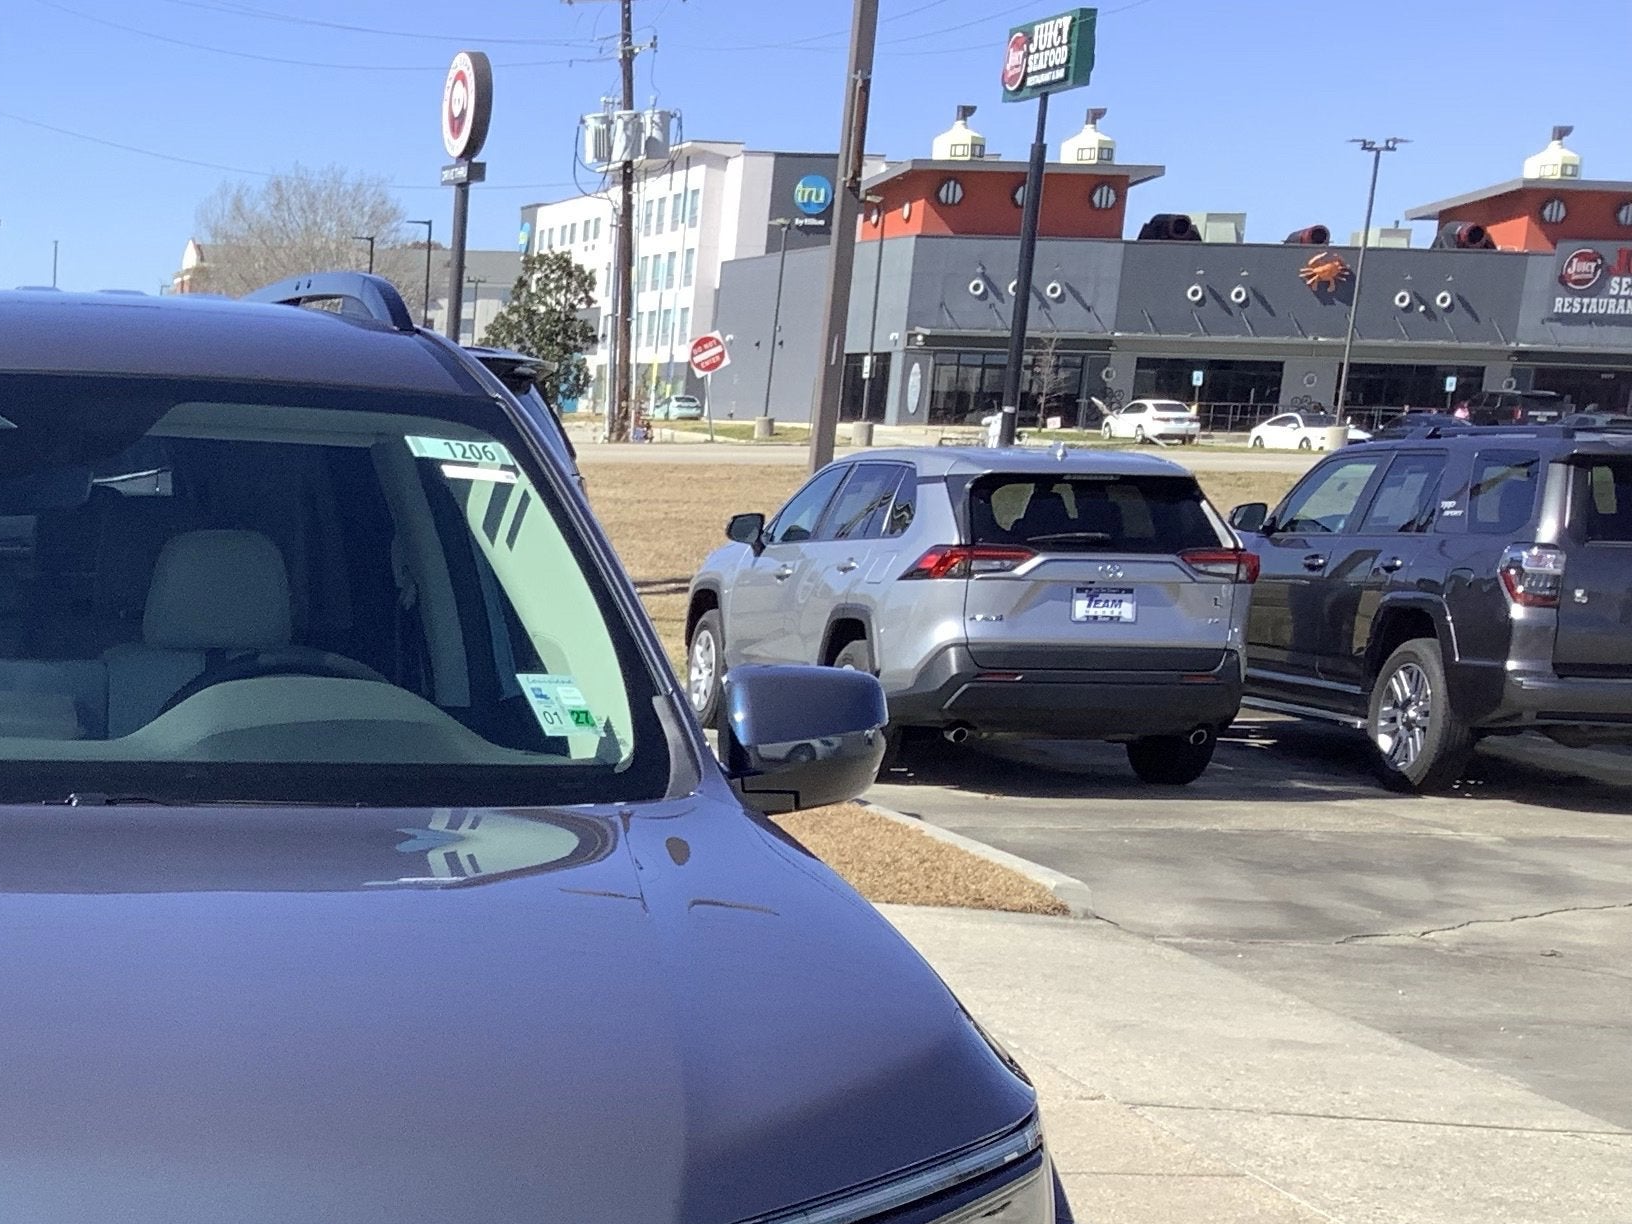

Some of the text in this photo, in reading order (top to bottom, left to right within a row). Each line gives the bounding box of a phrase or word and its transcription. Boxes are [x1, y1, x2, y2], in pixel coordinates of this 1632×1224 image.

[1029, 15, 1072, 53] JUICY
[1027, 45, 1068, 73] SEAFOOD
[797, 183, 826, 204] tru
[443, 441, 497, 461] 1206
[1086, 591, 1124, 609] TEAM
[542, 710, 591, 725] 01 27
